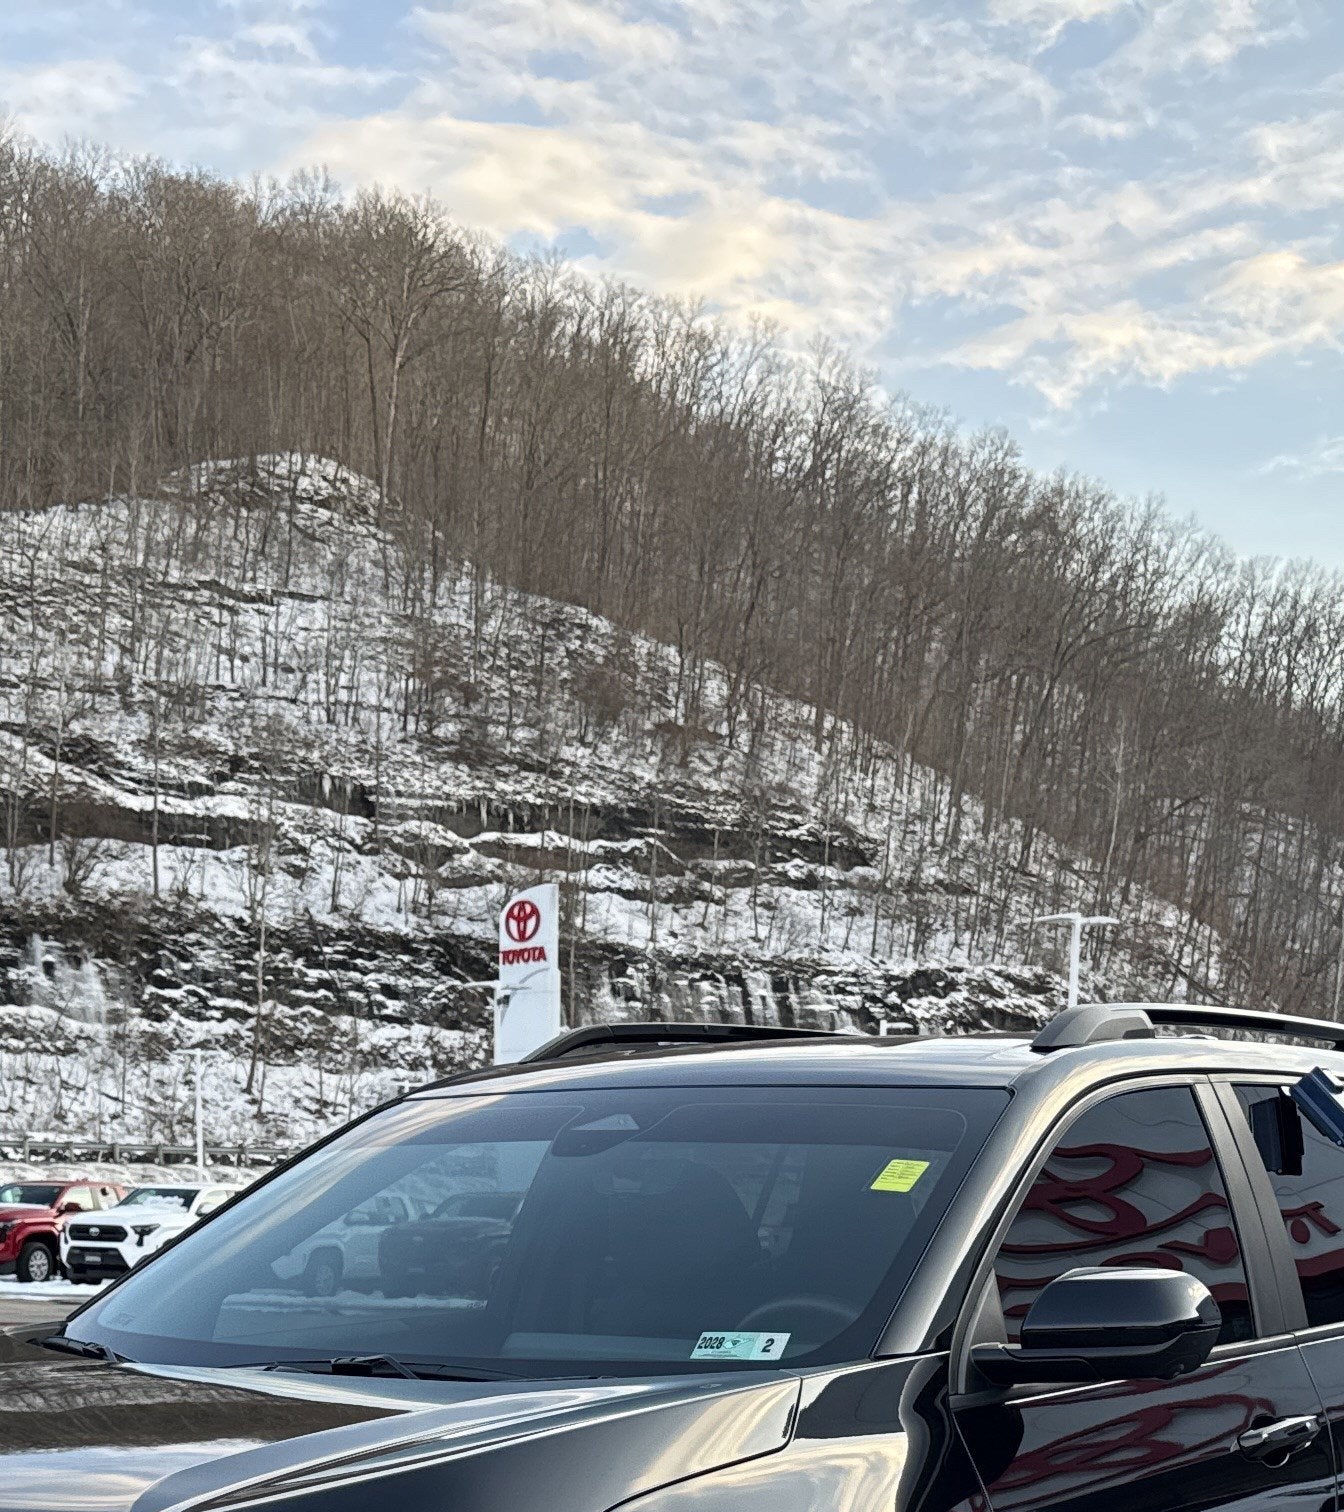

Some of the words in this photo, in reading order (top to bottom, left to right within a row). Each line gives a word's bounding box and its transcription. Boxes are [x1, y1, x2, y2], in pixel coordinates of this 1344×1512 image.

[500, 946, 547, 966] TOYOTA
[697, 1336, 726, 1350] 2028
[760, 1337, 776, 1353] 2
